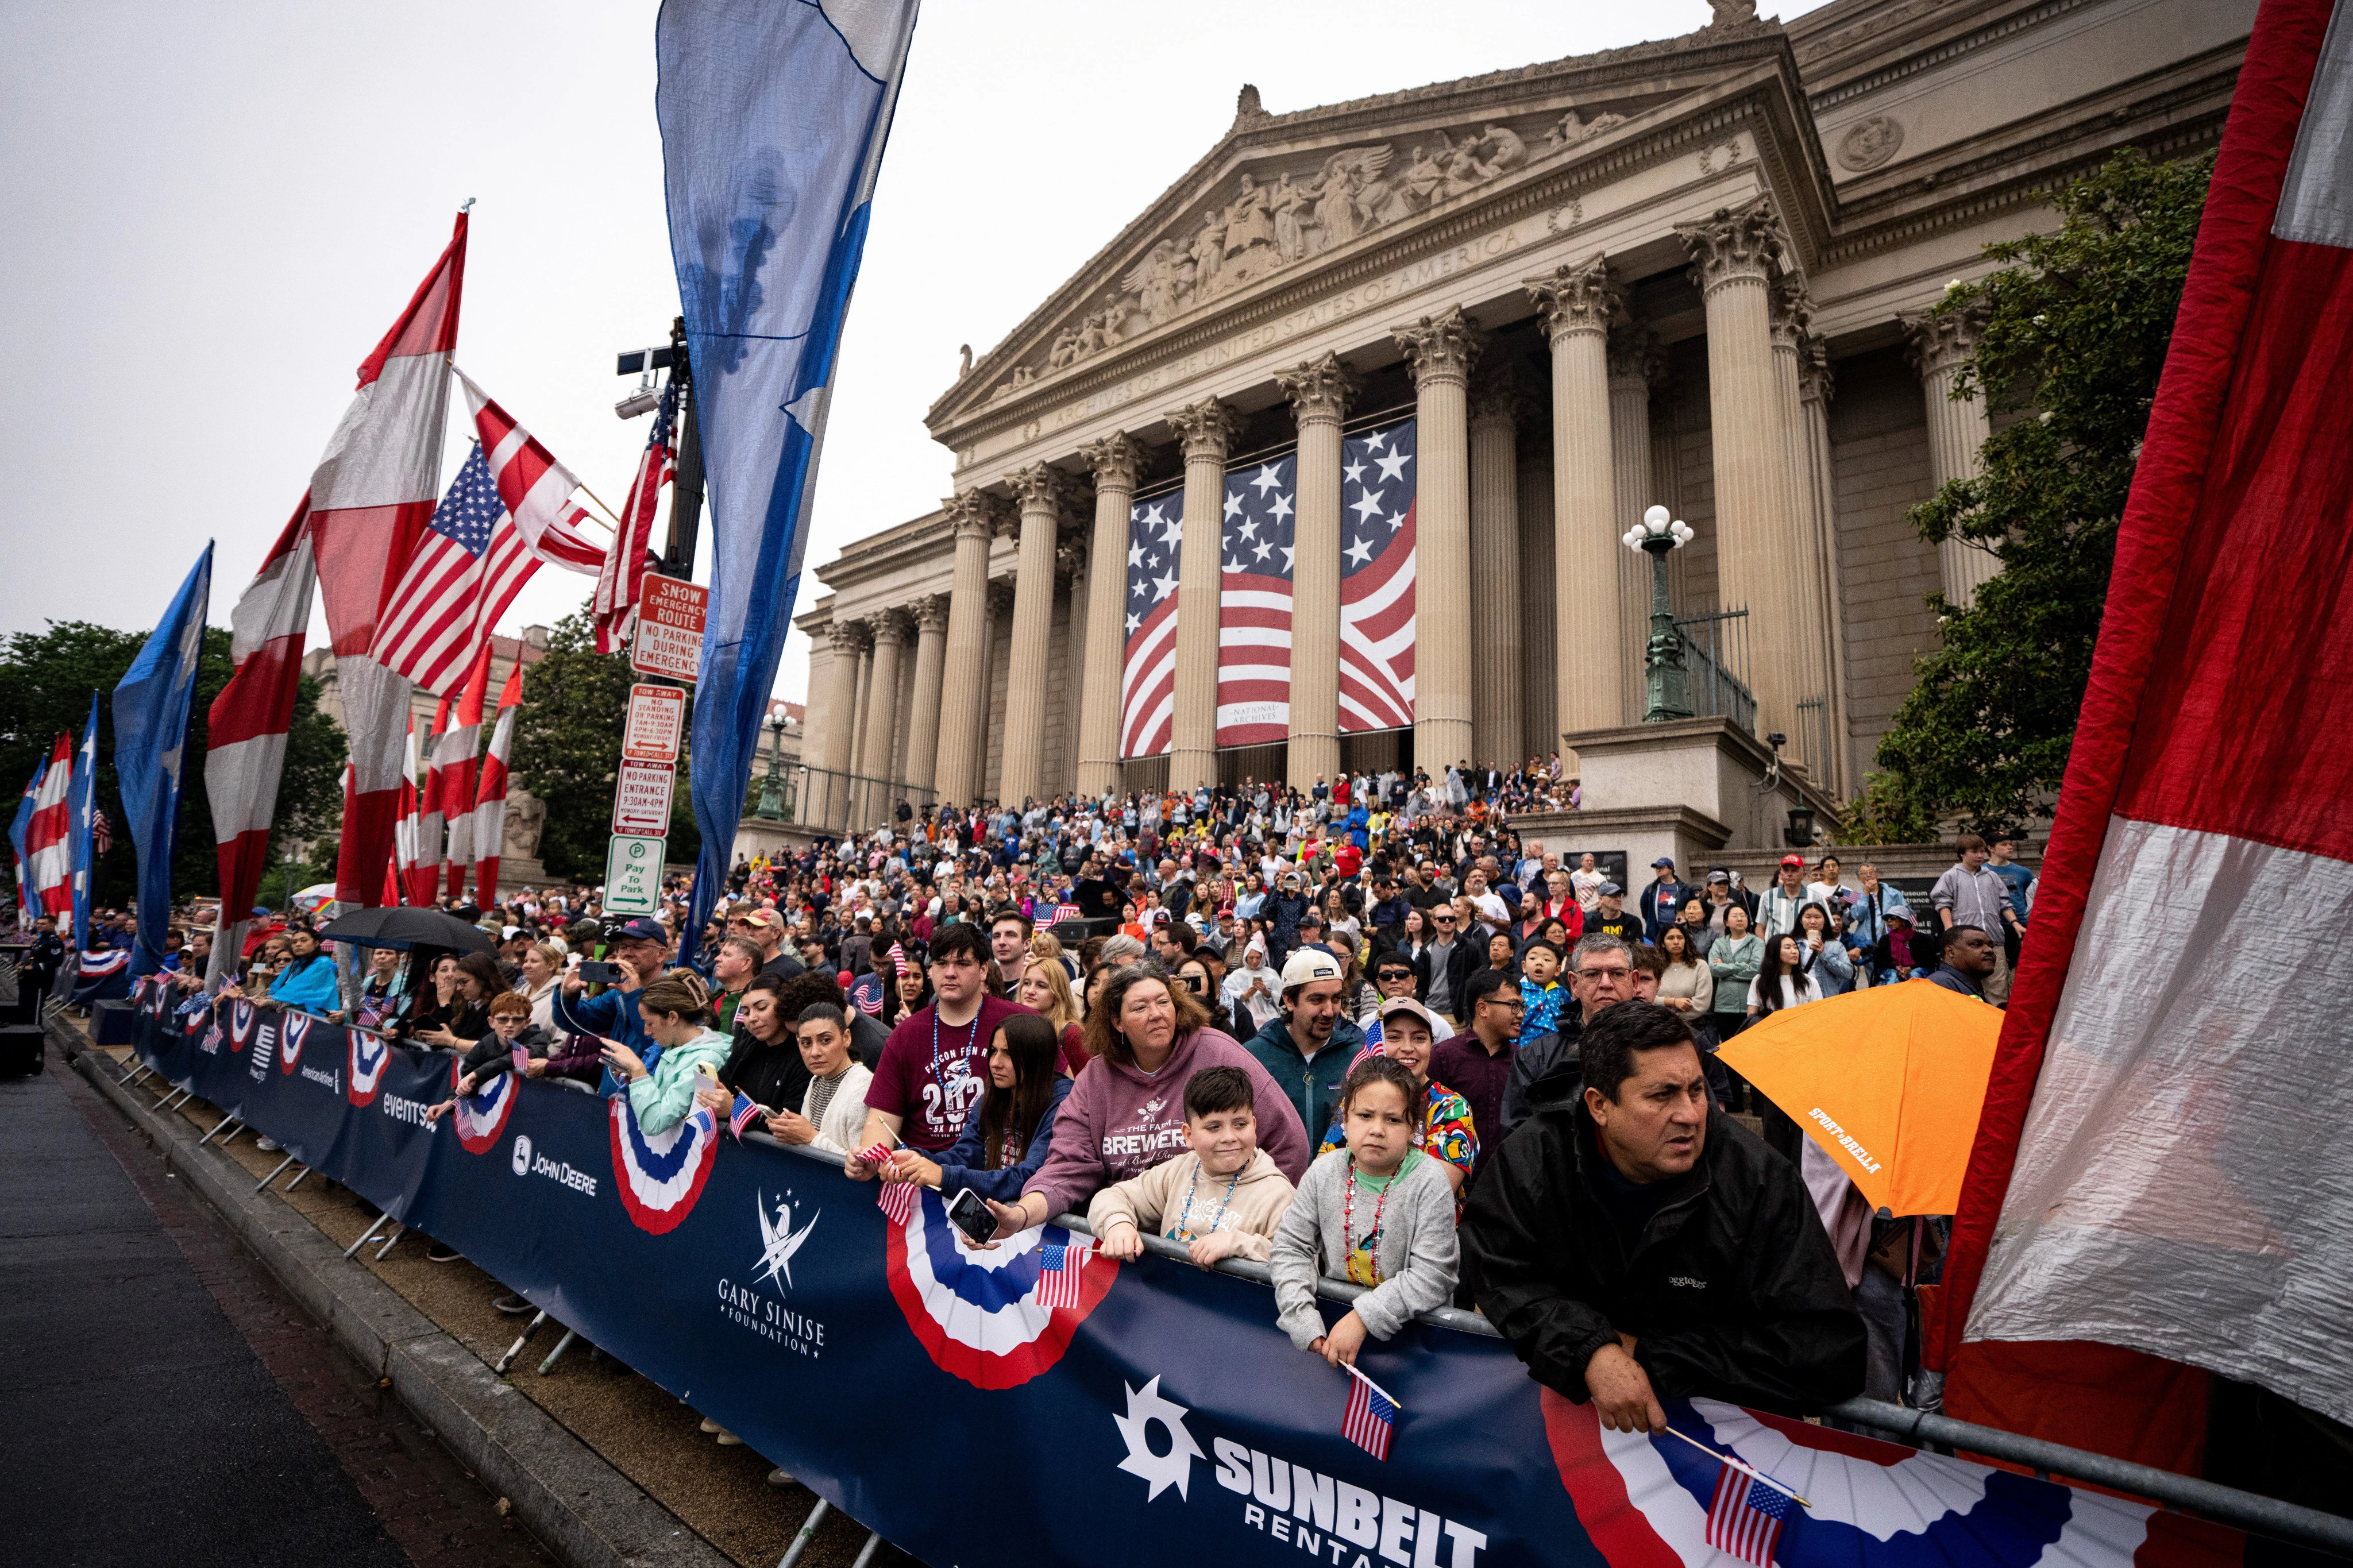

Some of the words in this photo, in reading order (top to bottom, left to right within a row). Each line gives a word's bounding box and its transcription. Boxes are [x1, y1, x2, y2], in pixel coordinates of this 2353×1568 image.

[1204, 325, 1276, 366] UNITED
[1283, 292, 1355, 335] STATES
[1363, 277, 1393, 303] OF
[1398, 229, 1519, 292] AMERICA
[660, 582, 701, 604] SNOW
[650, 594, 707, 617] EMERGENCY
[657, 608, 697, 629] ROUTE
[645, 624, 659, 637] NO
[653, 639, 694, 658] DURING
[655, 689, 677, 698] AWAY
[638, 704, 674, 714] STANDING
[1233, 704, 1275, 715] NATIONAL
[646, 713, 675, 721] PARKING
[1233, 712, 1275, 724] ARCHIVES
[647, 762, 667, 770] AWAY
[626, 771, 637, 781] NO
[638, 772, 668, 784] PARKING
[624, 783, 665, 796] ENTRANCE
[625, 863, 645, 874] Pay
[628, 875, 639, 883] To
[620, 885, 643, 894] Park
[1127, 1124, 1147, 1132] THE
[1150, 1119, 1171, 1131] FARM
[1117, 1158, 1127, 1167] at
[1127, 1151, 1156, 1165] Broad
[531, 1152, 561, 1181] JOHN
[560, 1162, 597, 1197] DEERE
[718, 1278, 760, 1315] GARY
[766, 1301, 824, 1346] SINISE
[728, 1307, 808, 1356] FOUNDATION
[1213, 1436, 1488, 1568] SUNBELT
